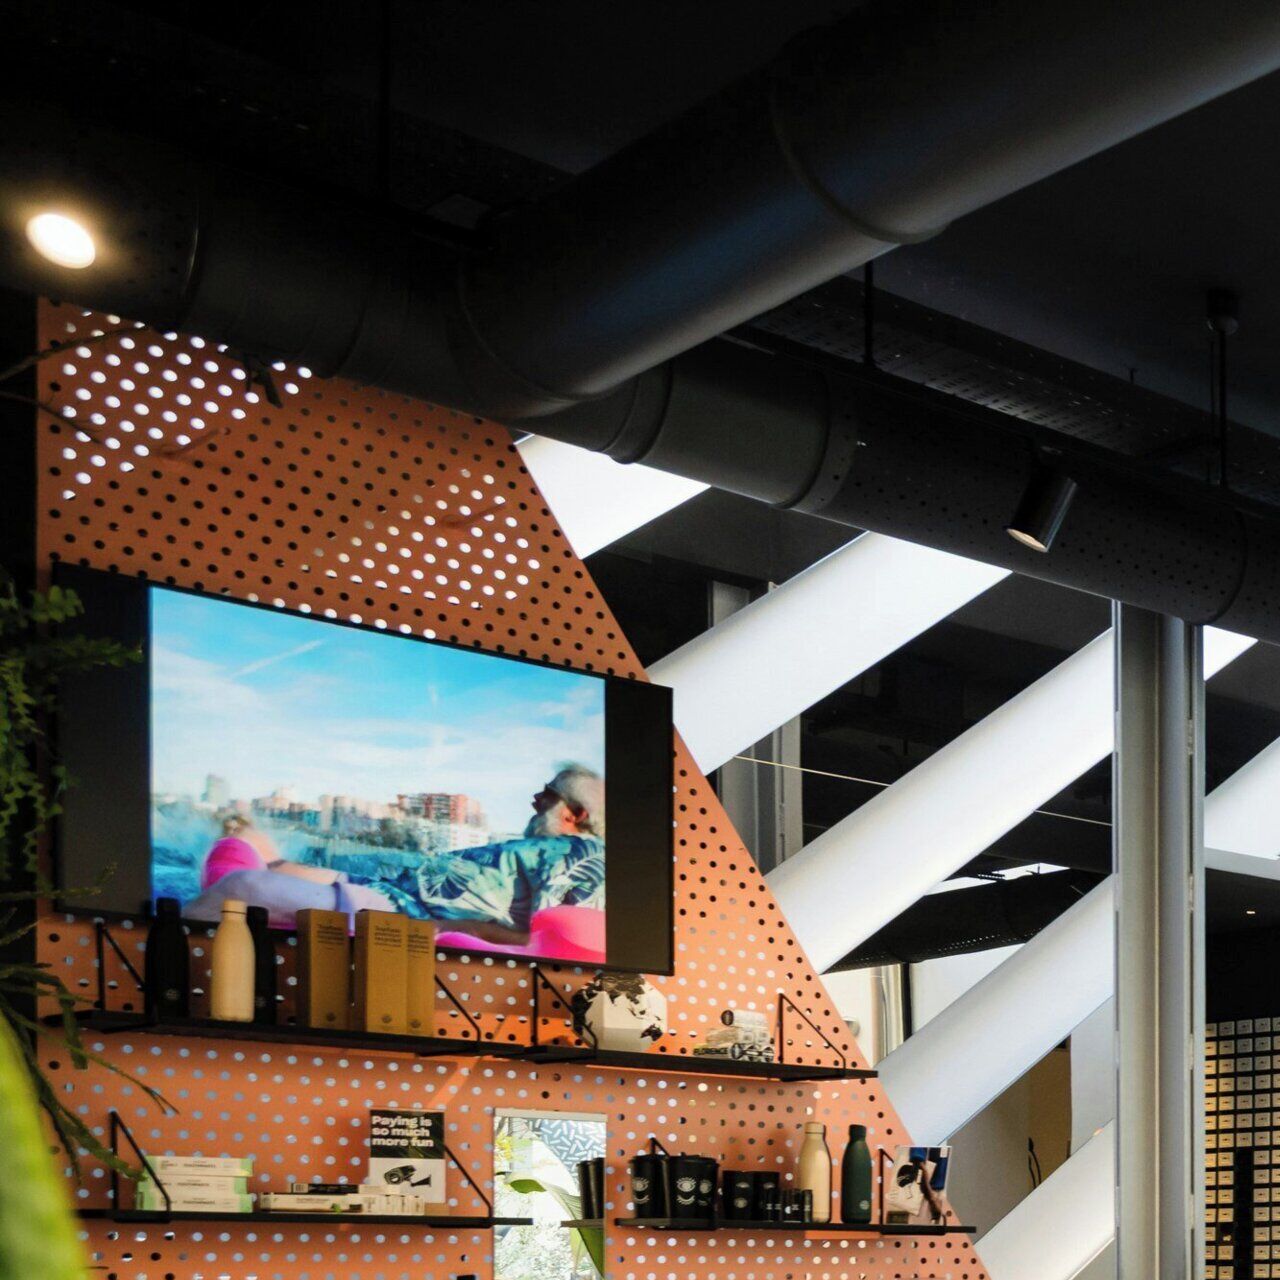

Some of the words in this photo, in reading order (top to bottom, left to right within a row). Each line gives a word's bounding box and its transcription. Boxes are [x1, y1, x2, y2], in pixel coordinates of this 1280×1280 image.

[371, 1115, 418, 1129] Paying
[420, 1116, 433, 1127] is
[372, 1127, 389, 1136] so
[391, 1127, 430, 1137] much
[372, 1138, 409, 1146] more
[410, 1137, 434, 1147] fun
